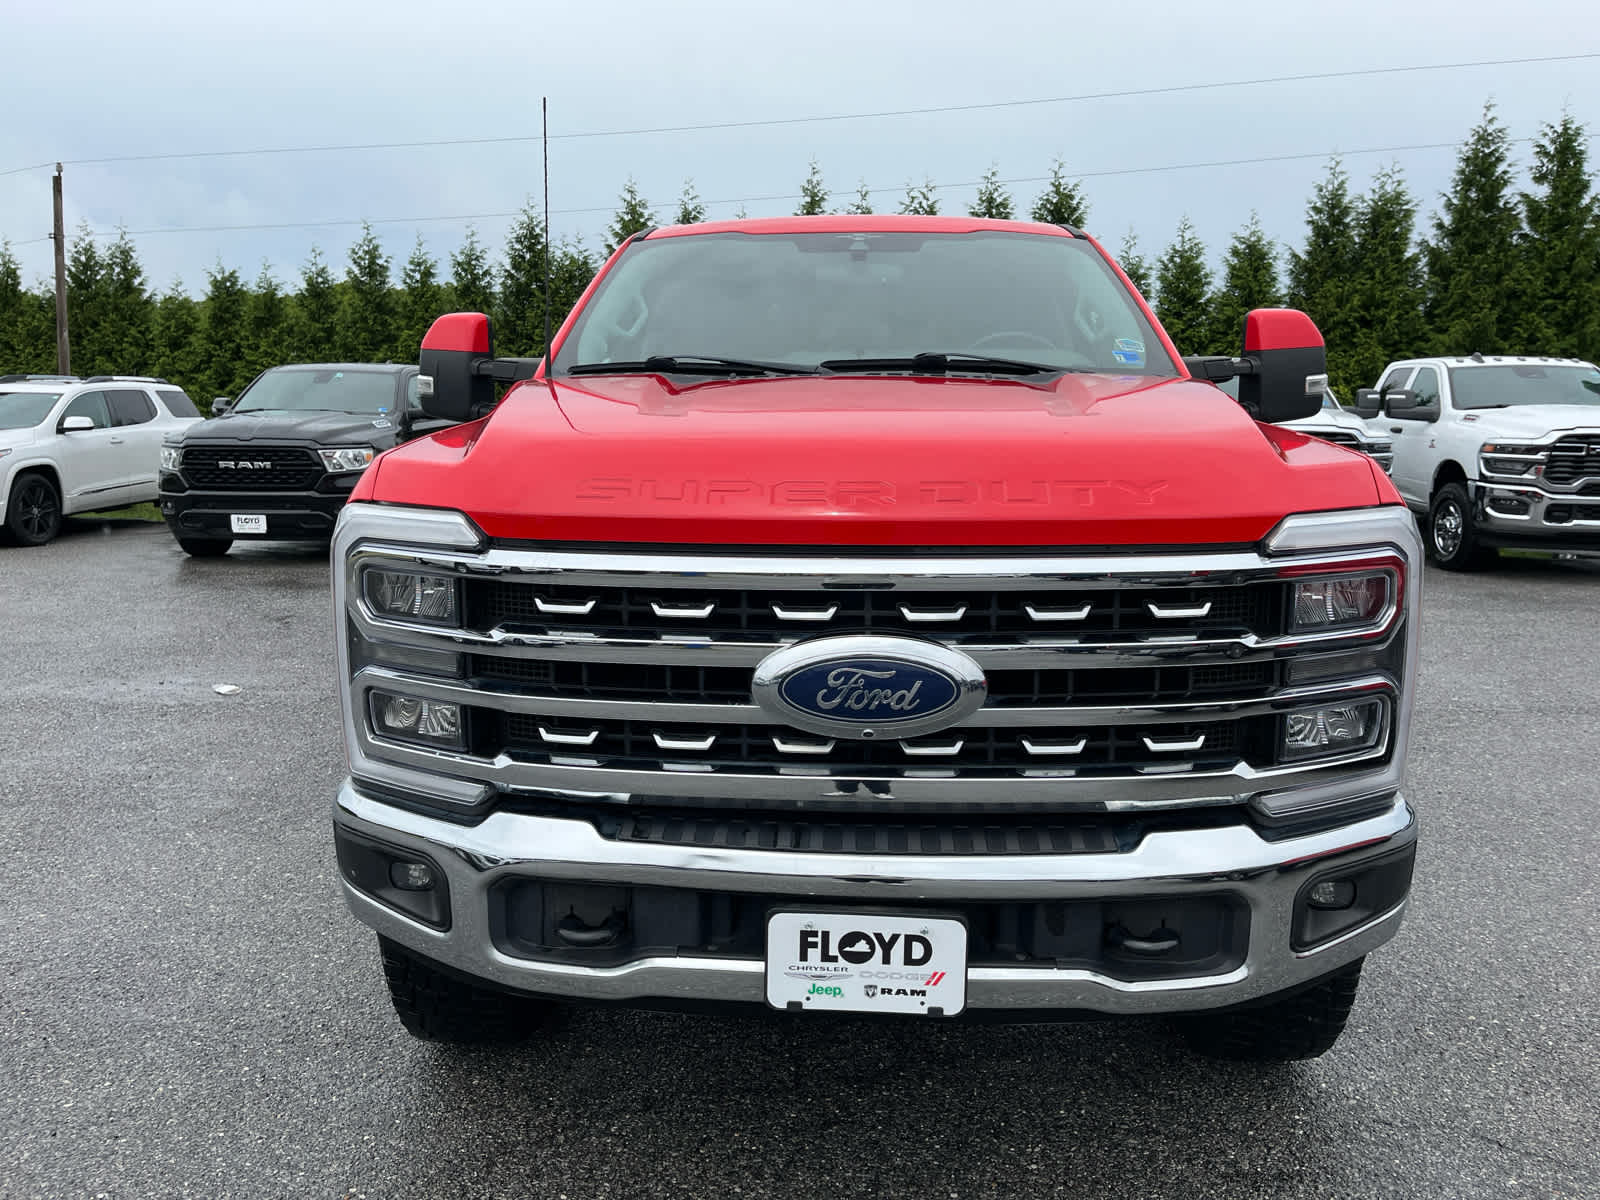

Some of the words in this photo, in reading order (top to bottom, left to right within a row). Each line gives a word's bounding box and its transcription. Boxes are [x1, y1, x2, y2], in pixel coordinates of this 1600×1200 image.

[218, 461, 272, 469] RAM
[575, 478, 897, 505] SUPER
[919, 479, 1168, 506] DUTY
[816, 667, 924, 710] Ford
[799, 930, 933, 967] FLOYD
[807, 983, 842, 998] Jeep
[880, 987, 927, 997] RAM
